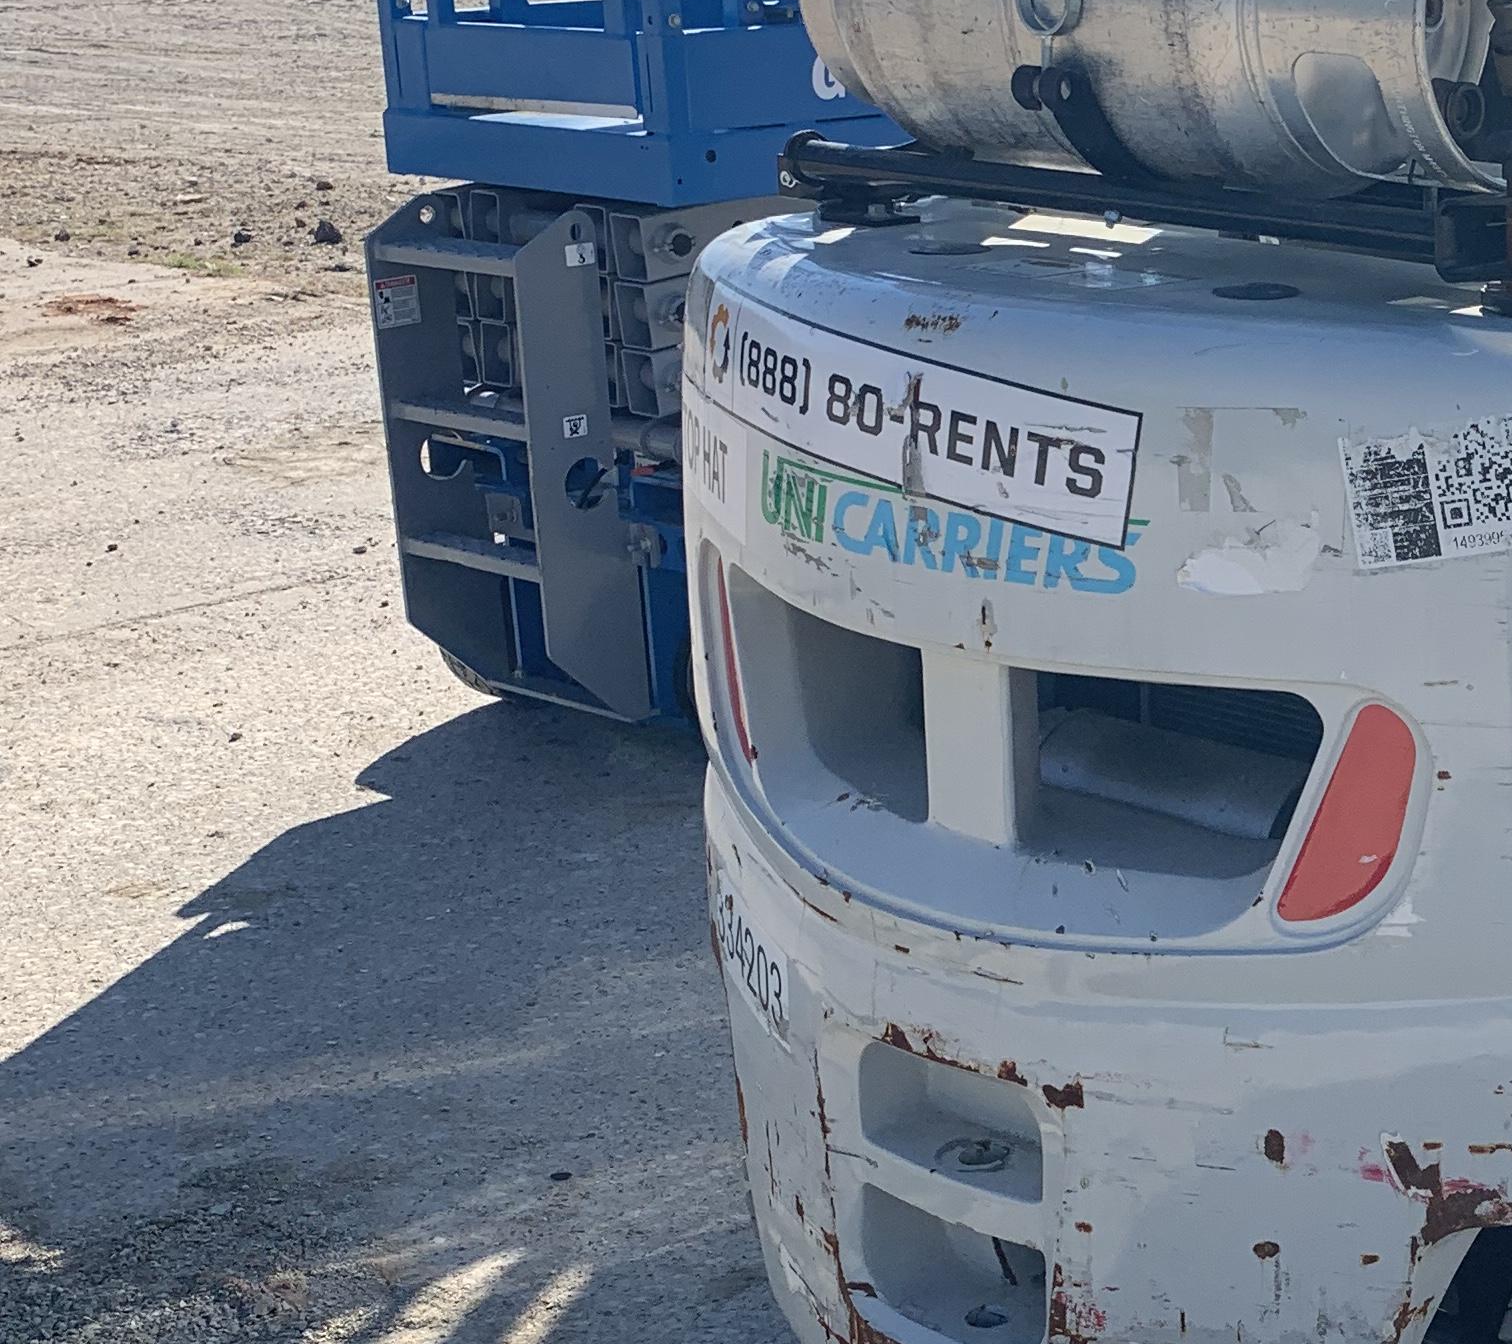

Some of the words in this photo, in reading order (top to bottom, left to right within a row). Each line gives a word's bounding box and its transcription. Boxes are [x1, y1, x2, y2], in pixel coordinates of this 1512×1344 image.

[703, 426, 728, 504] HAT
[739, 330, 811, 415] (888)
[827, 373, 1105, 499] 80-RENTS
[761, 450, 1144, 594] UNICARRIERS
[717, 894, 784, 1031] 334203
